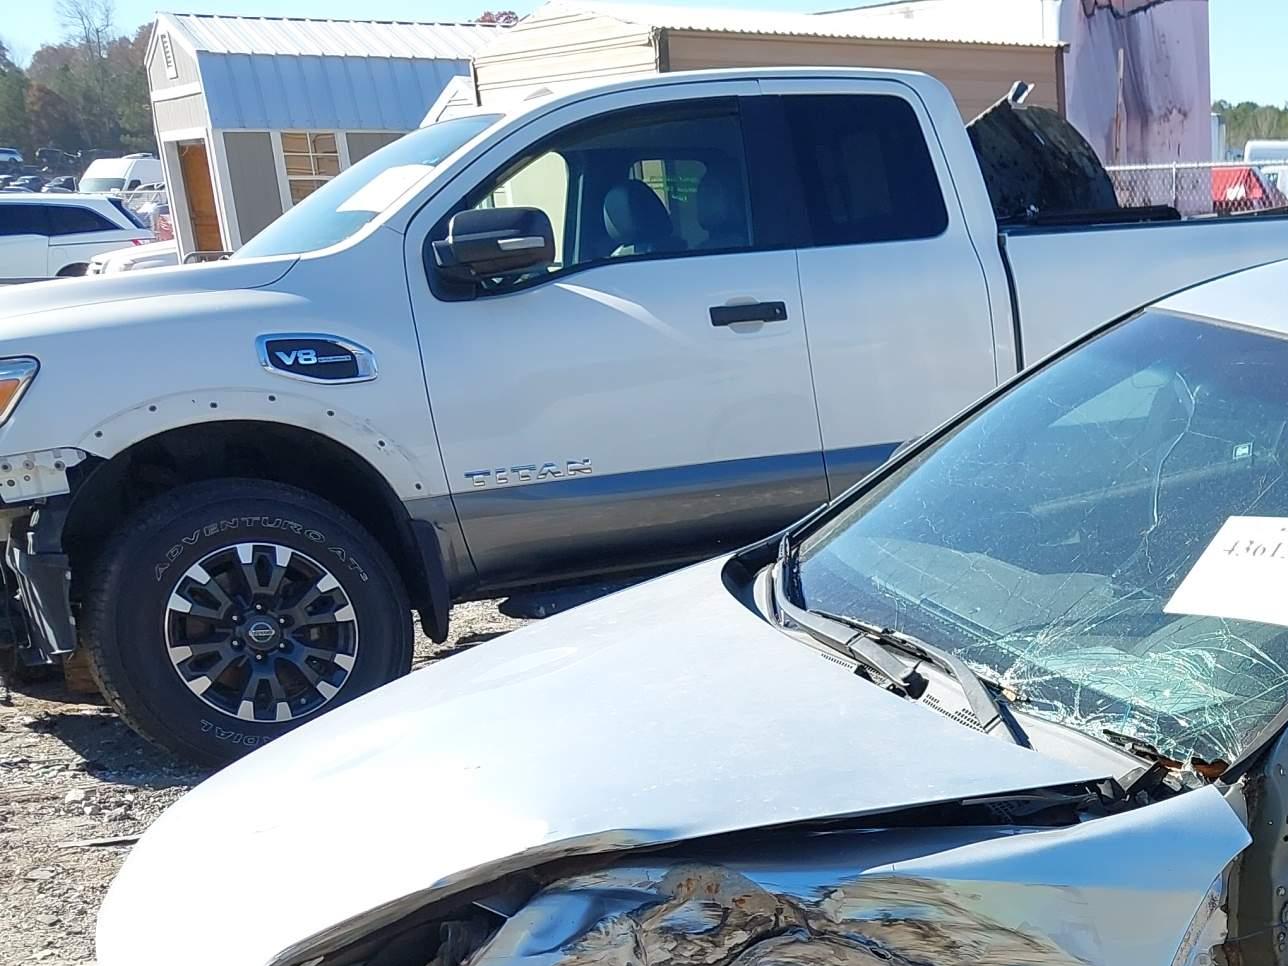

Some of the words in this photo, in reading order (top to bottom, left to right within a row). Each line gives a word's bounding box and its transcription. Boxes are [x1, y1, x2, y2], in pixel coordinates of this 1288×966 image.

[275, 349, 318, 366] V8
[464, 458, 592, 487] TITAN
[155, 516, 325, 582] ADVENTURO
